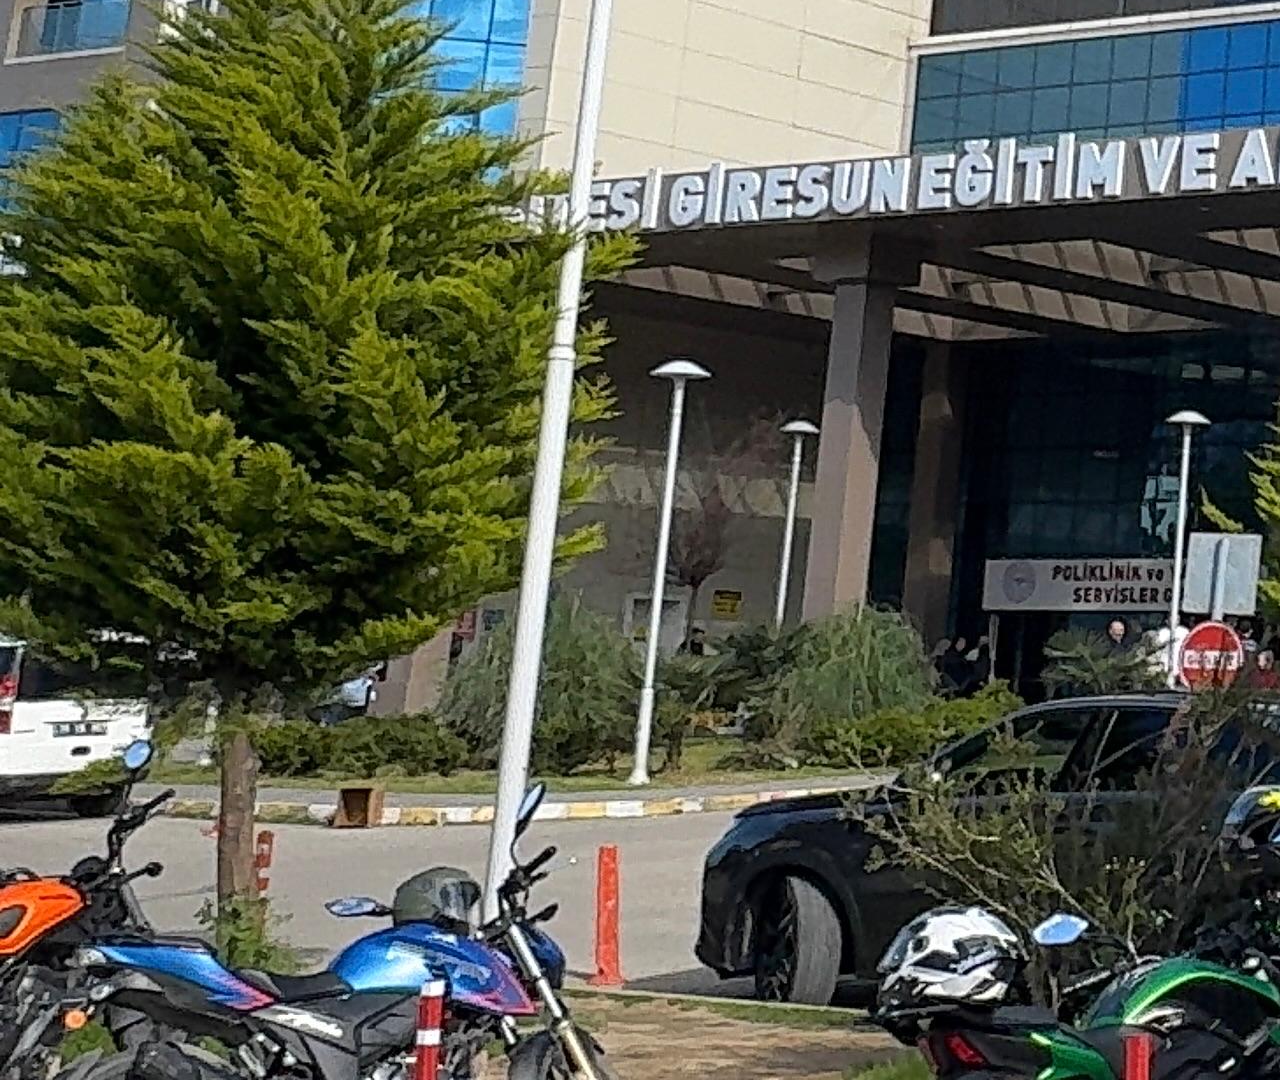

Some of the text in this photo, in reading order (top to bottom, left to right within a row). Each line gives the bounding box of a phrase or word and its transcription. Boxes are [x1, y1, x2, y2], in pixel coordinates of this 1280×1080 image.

[668, 157, 911, 227] GİRESUN
[916, 132, 1127, 210] EĞİTİM
[1139, 132, 1221, 195] VE
[1051, 561, 1142, 581] POLİKLİNİK
[1072, 583, 1160, 603] SERVİSLER
